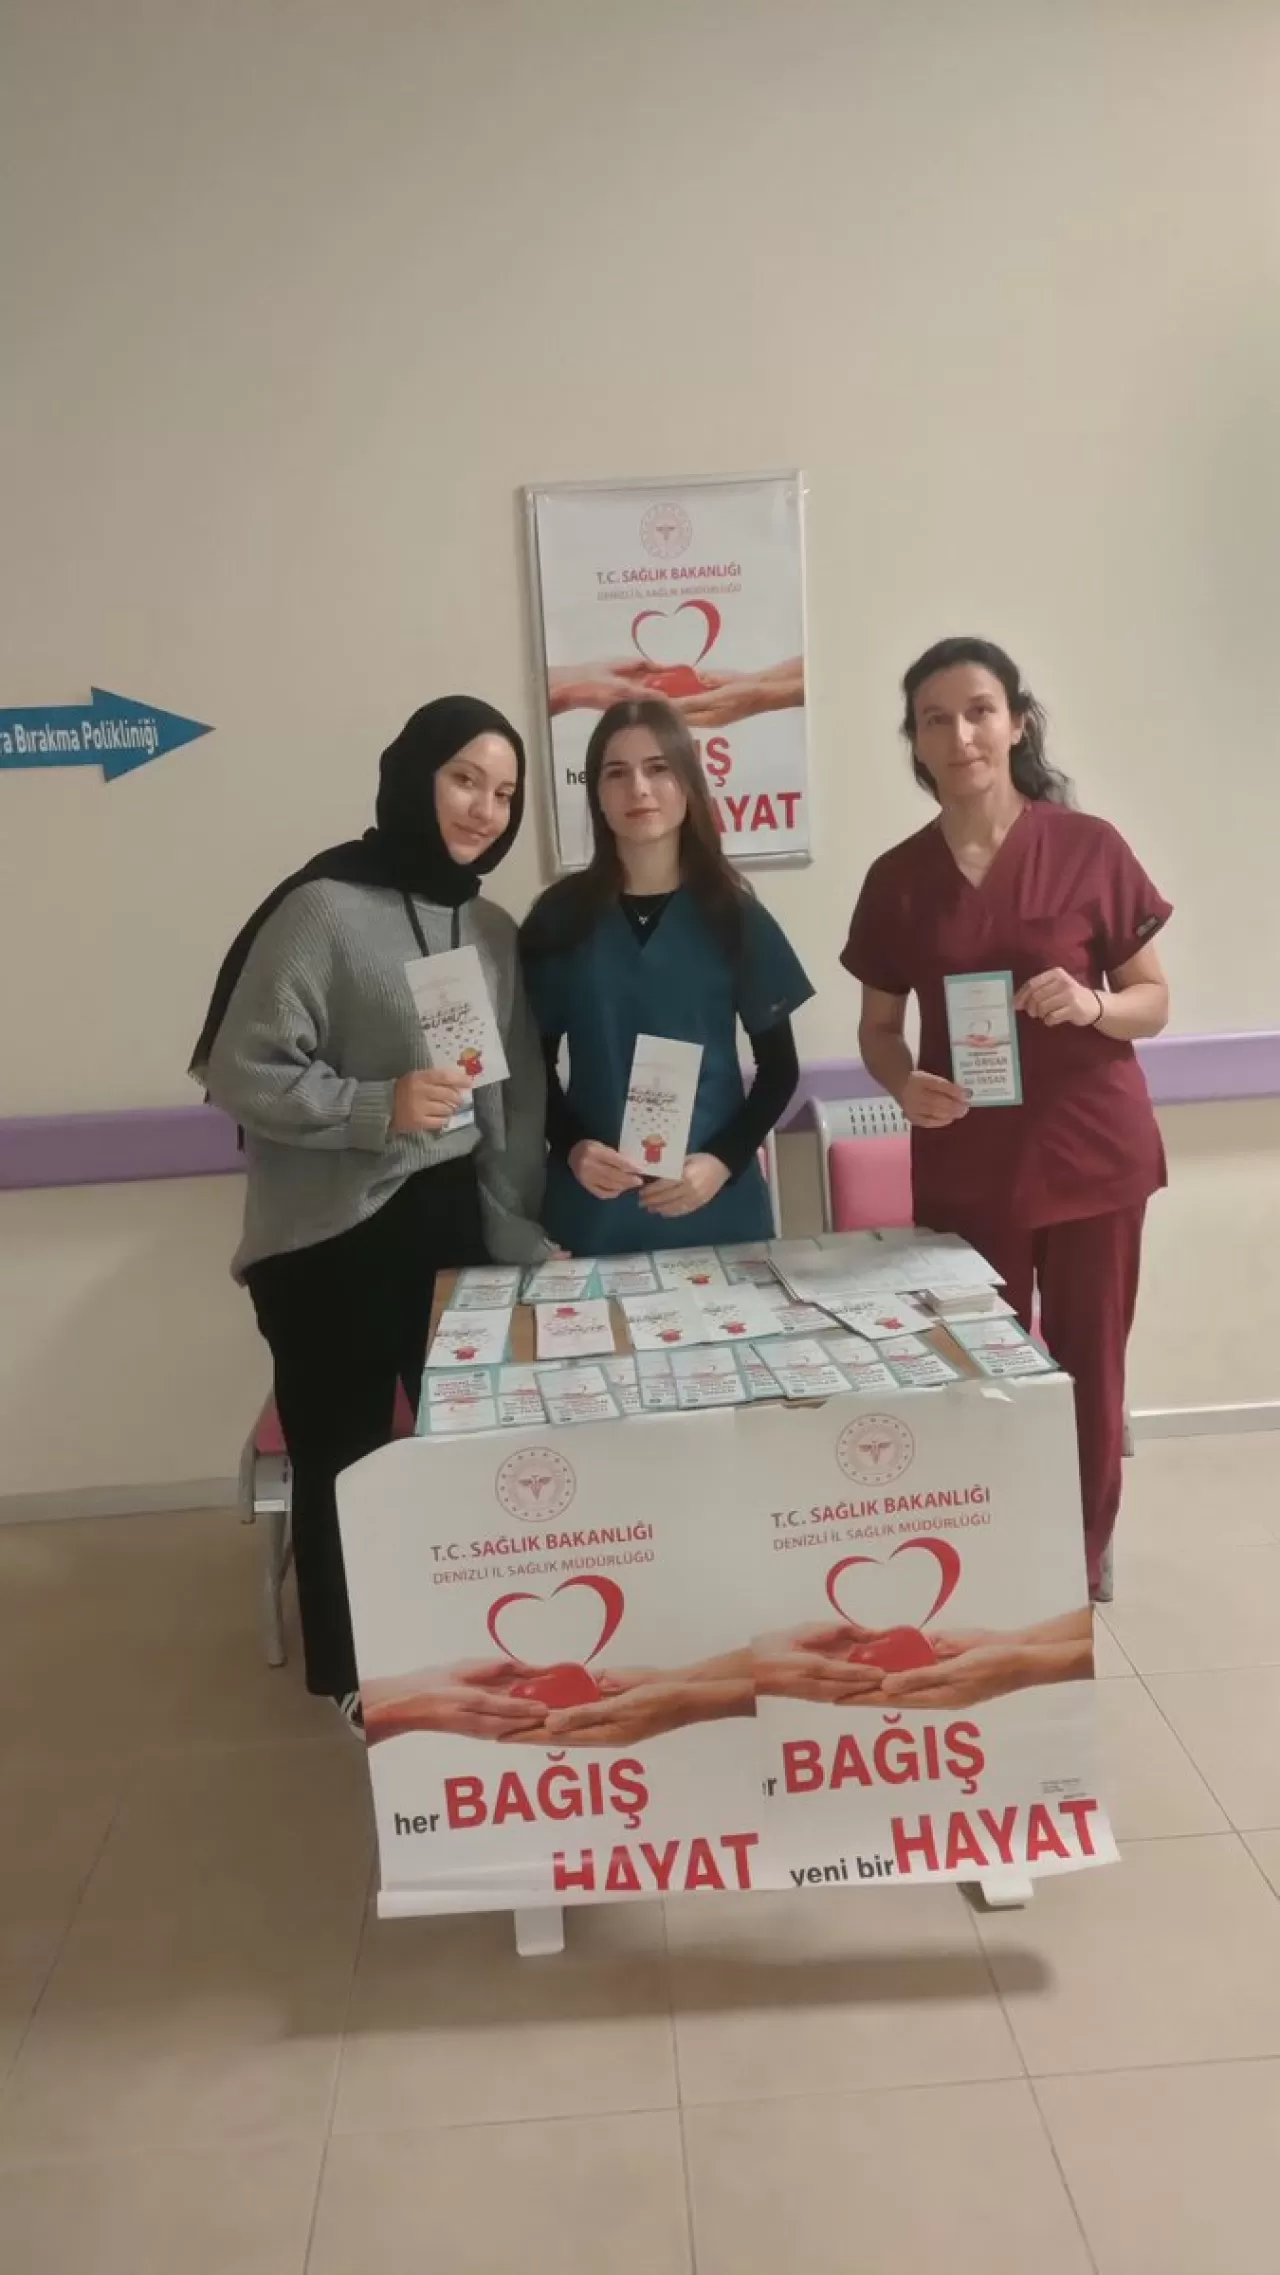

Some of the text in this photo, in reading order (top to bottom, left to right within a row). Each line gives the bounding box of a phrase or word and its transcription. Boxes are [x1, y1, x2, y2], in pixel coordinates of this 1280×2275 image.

[596, 561, 742, 585] T.C. SAĞLIK BAKANLIĞI
[14, 722, 81, 754] Bırakma
[81, 717, 159, 755] Polikliniği
[770, 1484, 991, 1529] T.C. SAĞLIK BAKANLIĞI
[430, 1520, 654, 1563] T.C. SAĞLIK BAKANLIĞI
[846, 1522, 896, 1541] SAĞLIK
[508, 1560, 558, 1577] SAĞLIK
[782, 1713, 986, 1795] BAĞIŞ
[394, 1750, 650, 1836] her BAĞIŞ
[552, 1832, 759, 1892] HAYAT
[789, 1799, 1098, 1888] yeni bir HAYAT
